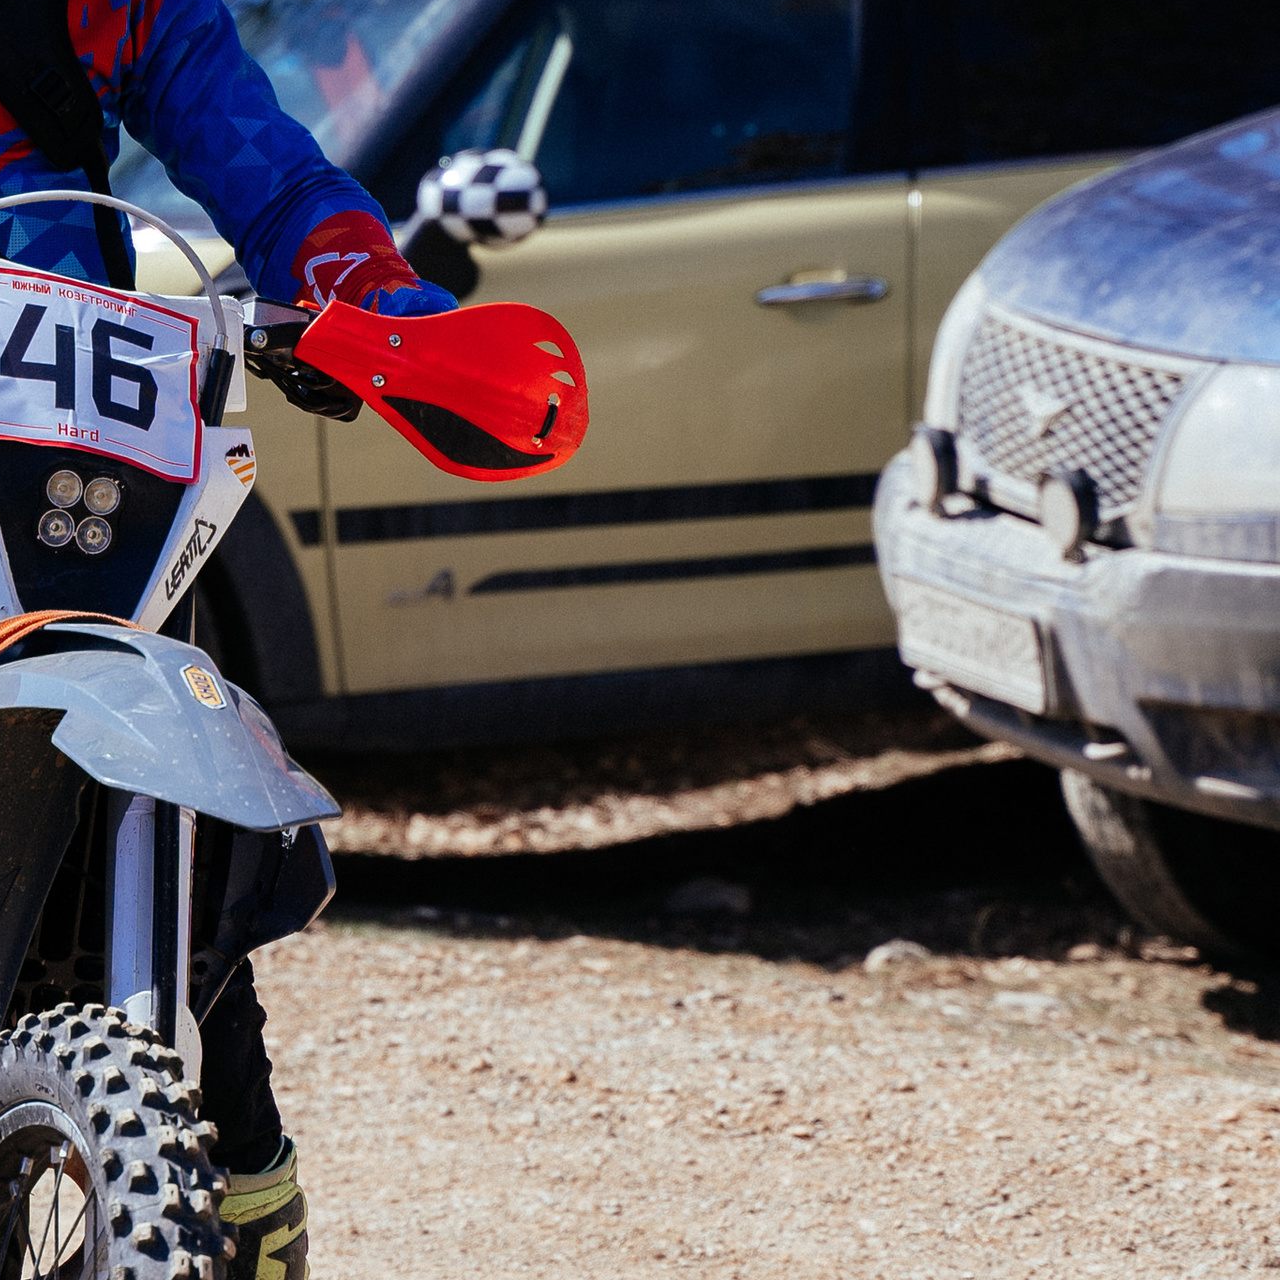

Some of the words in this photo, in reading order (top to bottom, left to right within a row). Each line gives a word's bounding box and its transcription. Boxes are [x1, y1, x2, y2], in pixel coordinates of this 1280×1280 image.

[12, 279, 51, 295] ЮЖНЫЙ
[58, 287, 138, 318] КОЗЕТРОПИНГ
[0, 303, 158, 432] 46
[57, 422, 100, 443] Hard
